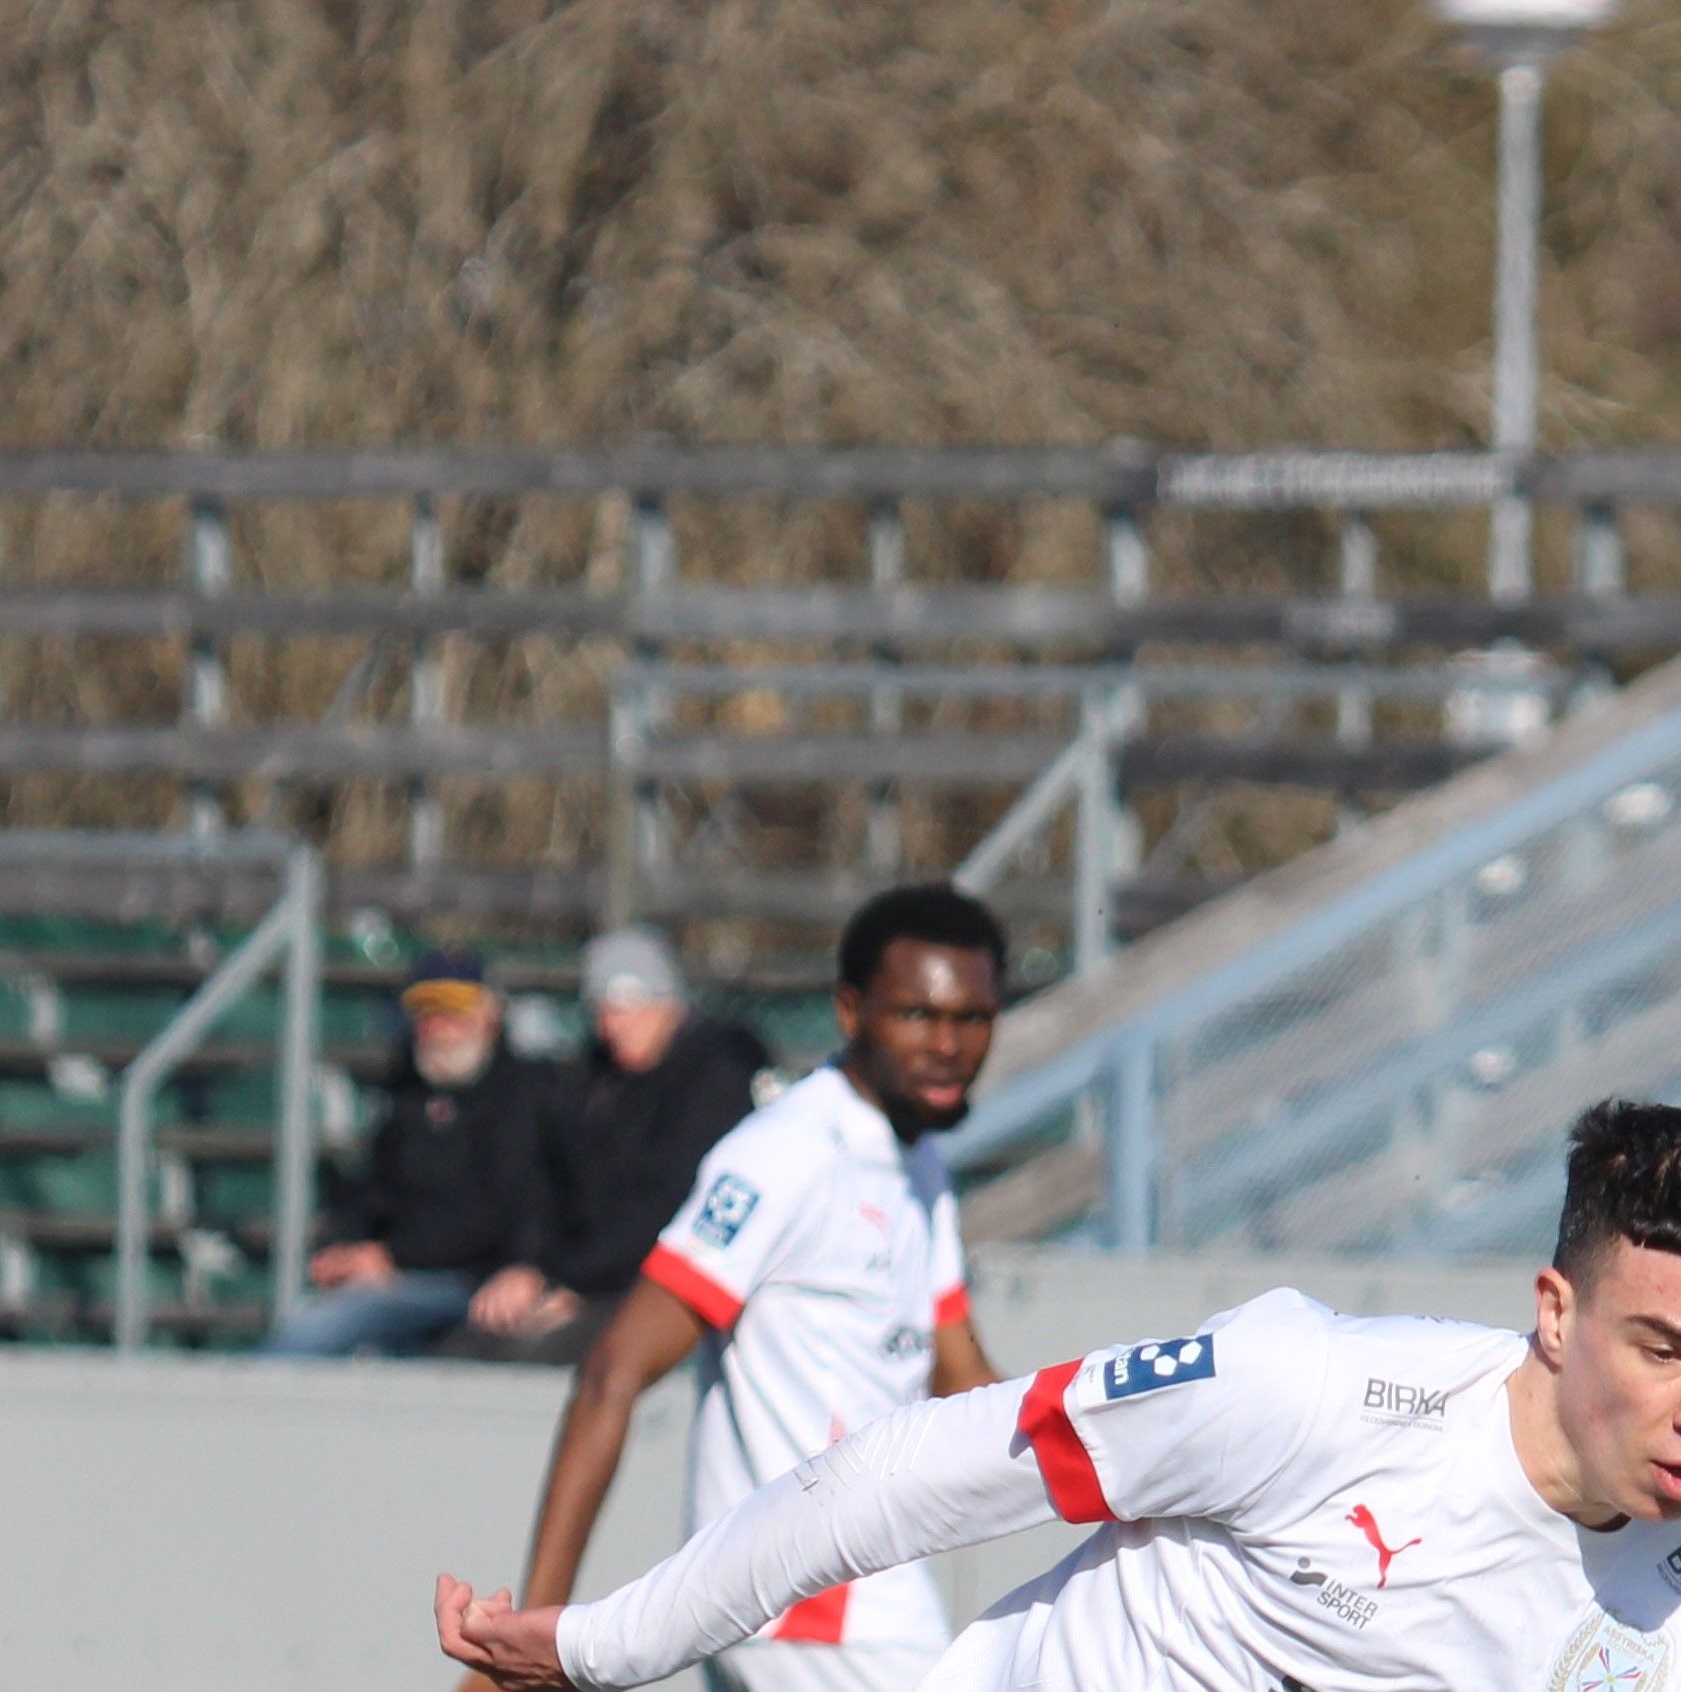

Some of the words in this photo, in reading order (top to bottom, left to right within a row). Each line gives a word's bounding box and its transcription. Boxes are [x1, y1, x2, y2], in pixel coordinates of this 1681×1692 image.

[1363, 1378, 1450, 1417] BIRKA
[1316, 1591, 1371, 1630] SPORT
[1326, 1579, 1379, 1618] INTER
